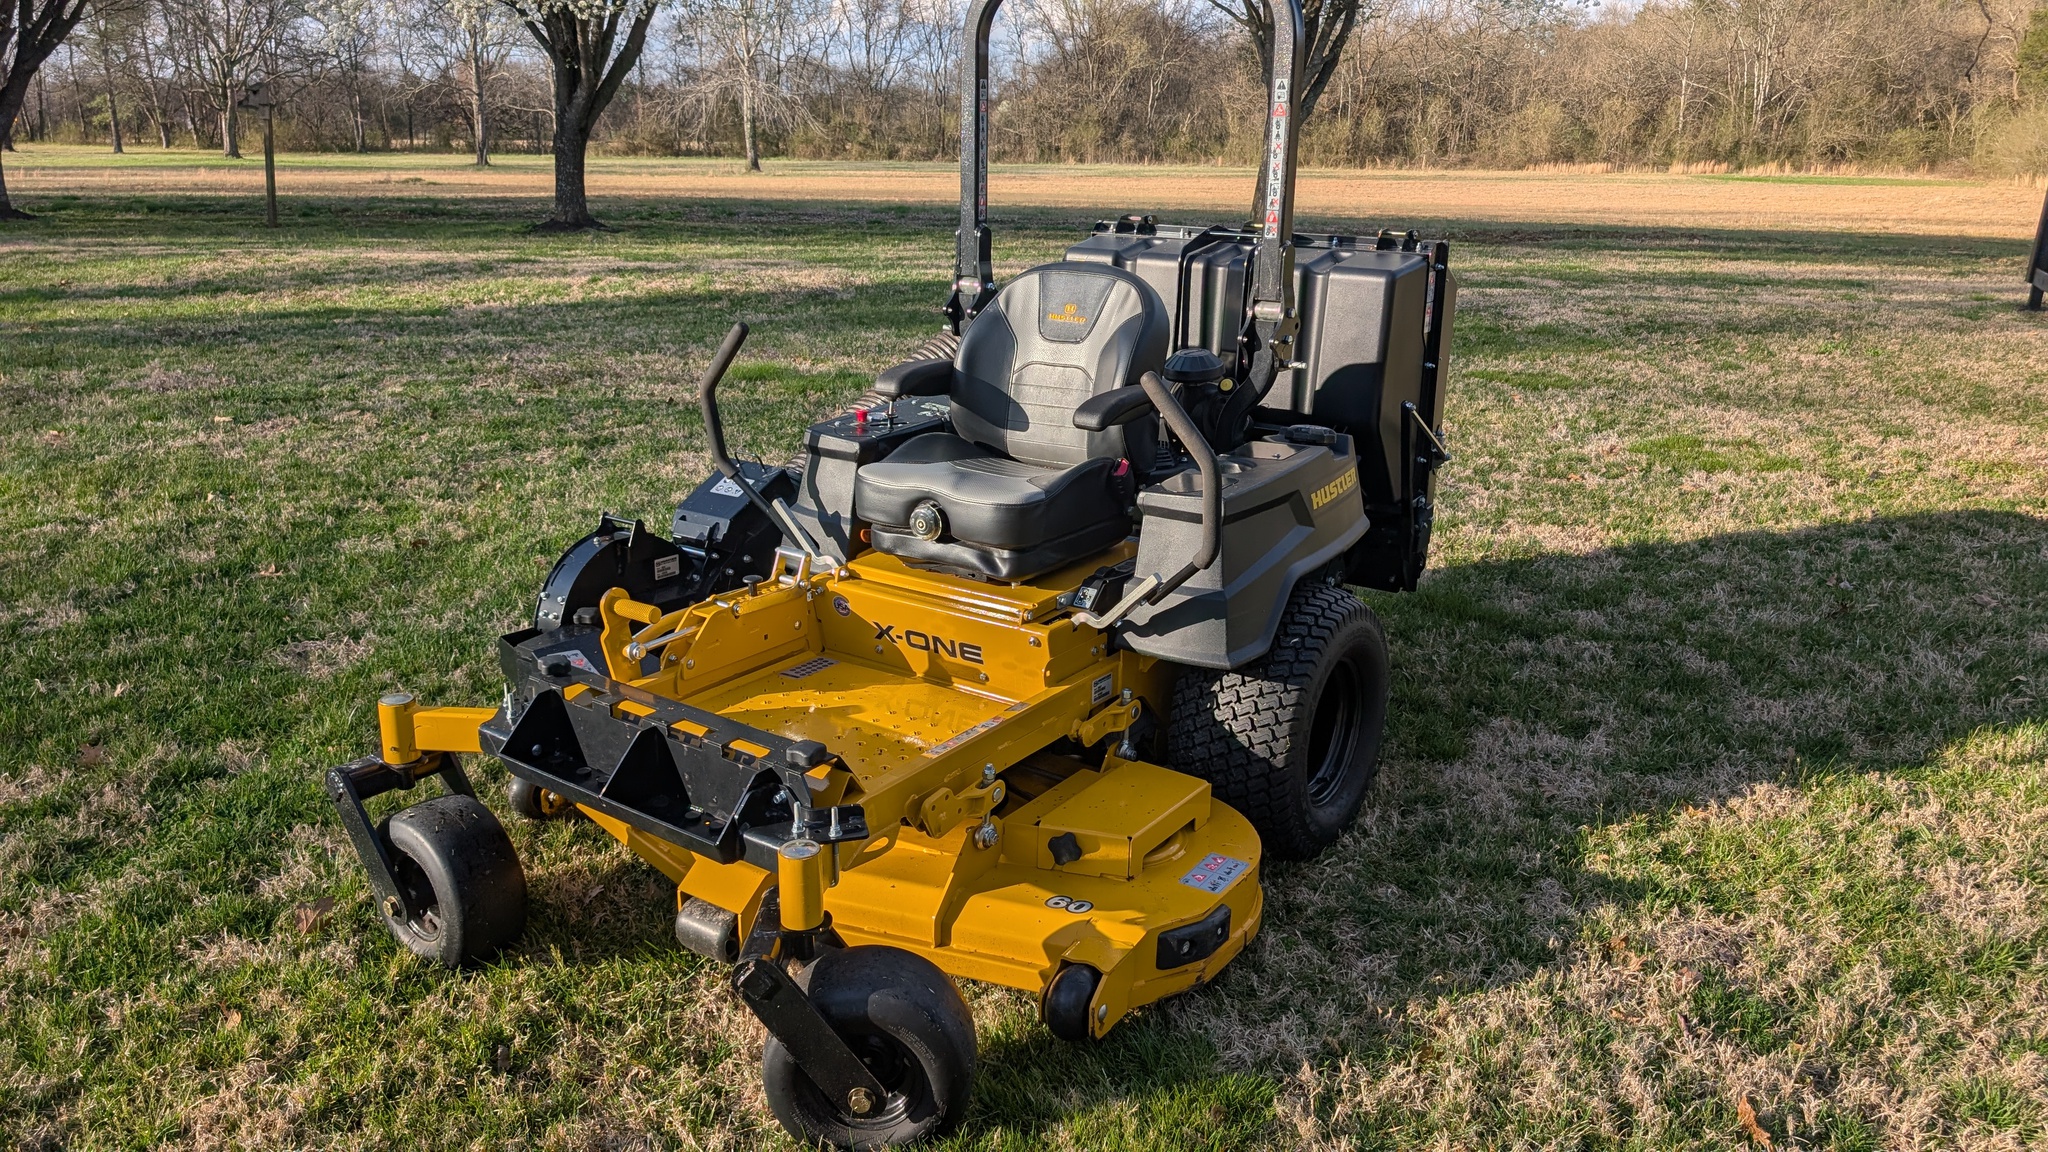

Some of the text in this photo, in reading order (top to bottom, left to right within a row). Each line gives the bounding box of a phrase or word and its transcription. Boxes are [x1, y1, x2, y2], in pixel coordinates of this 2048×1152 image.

[1310, 467, 1357, 510] HUSTLER
[872, 621, 984, 665] X-ONE
[1044, 895, 1094, 914] 60
